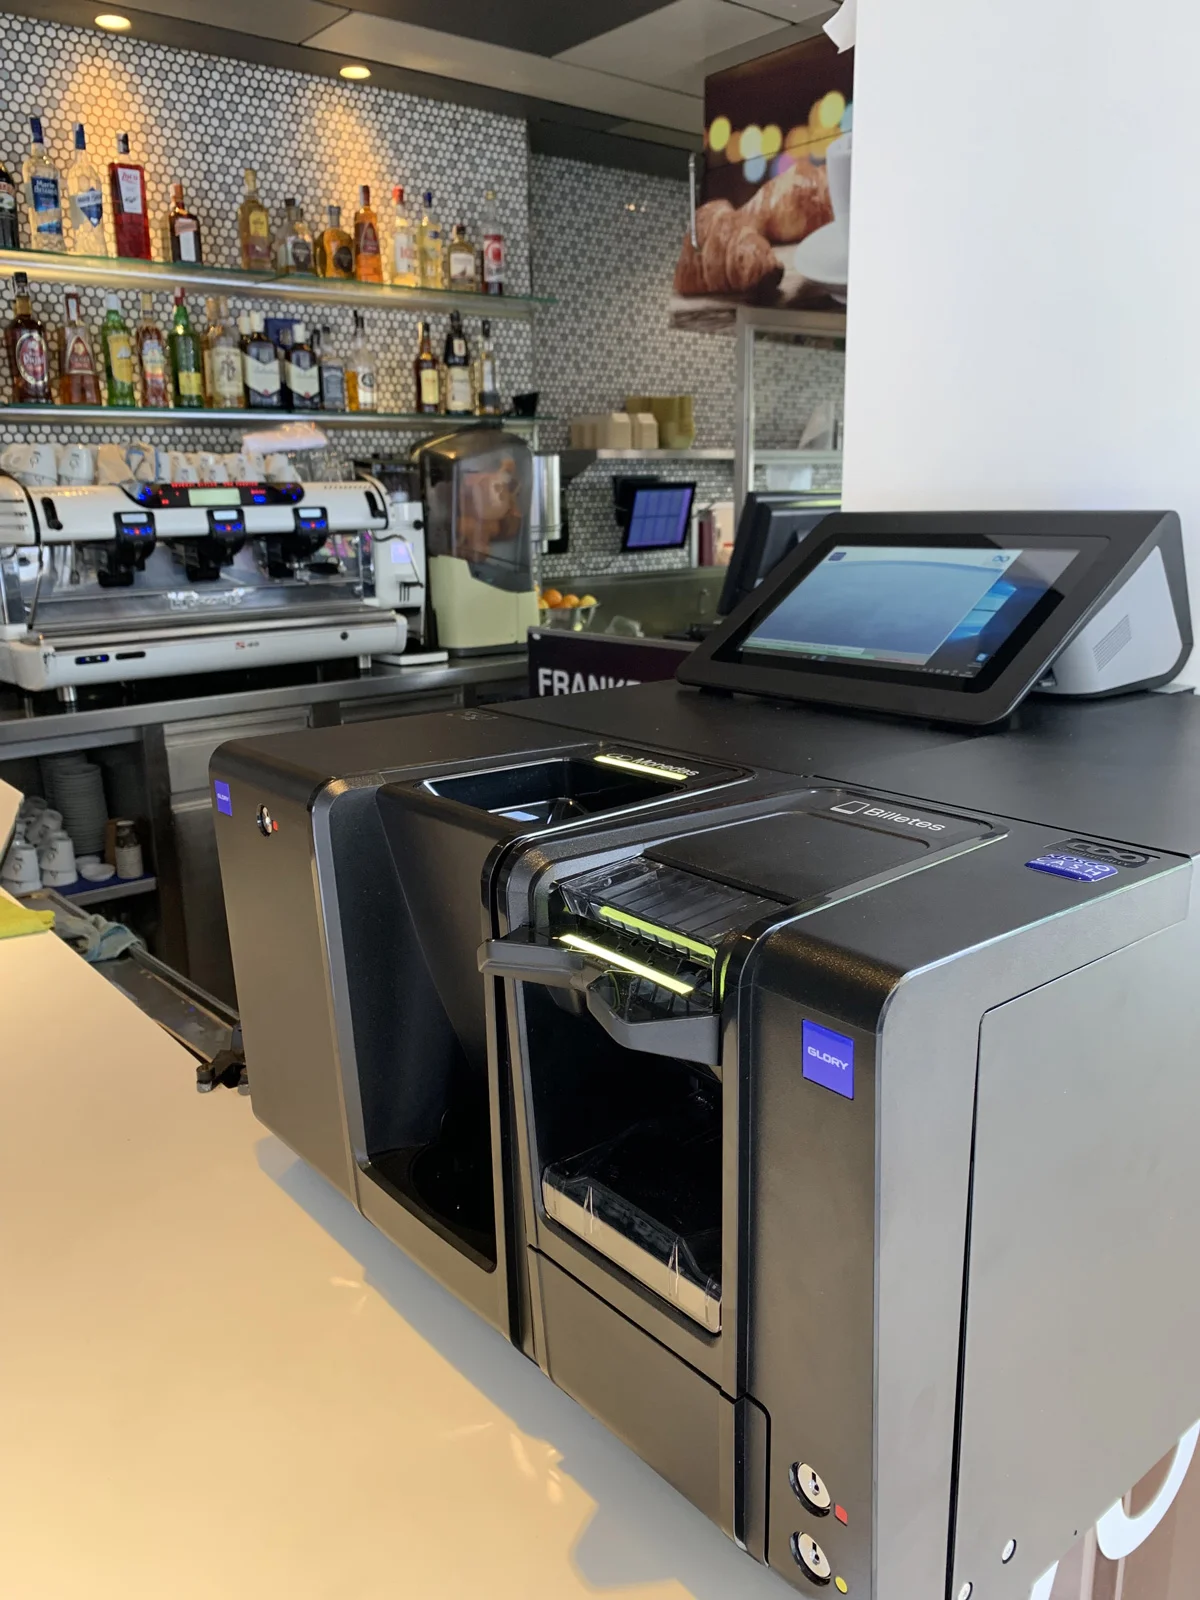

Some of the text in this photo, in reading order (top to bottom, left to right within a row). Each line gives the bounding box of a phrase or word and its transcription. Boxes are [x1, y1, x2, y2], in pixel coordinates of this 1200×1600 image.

[863, 807, 946, 832] Billetes
[1036, 857, 1102, 876] CASH
[1045, 854, 1111, 872] KIOSCO
[807, 1046, 849, 1070] GLORY
